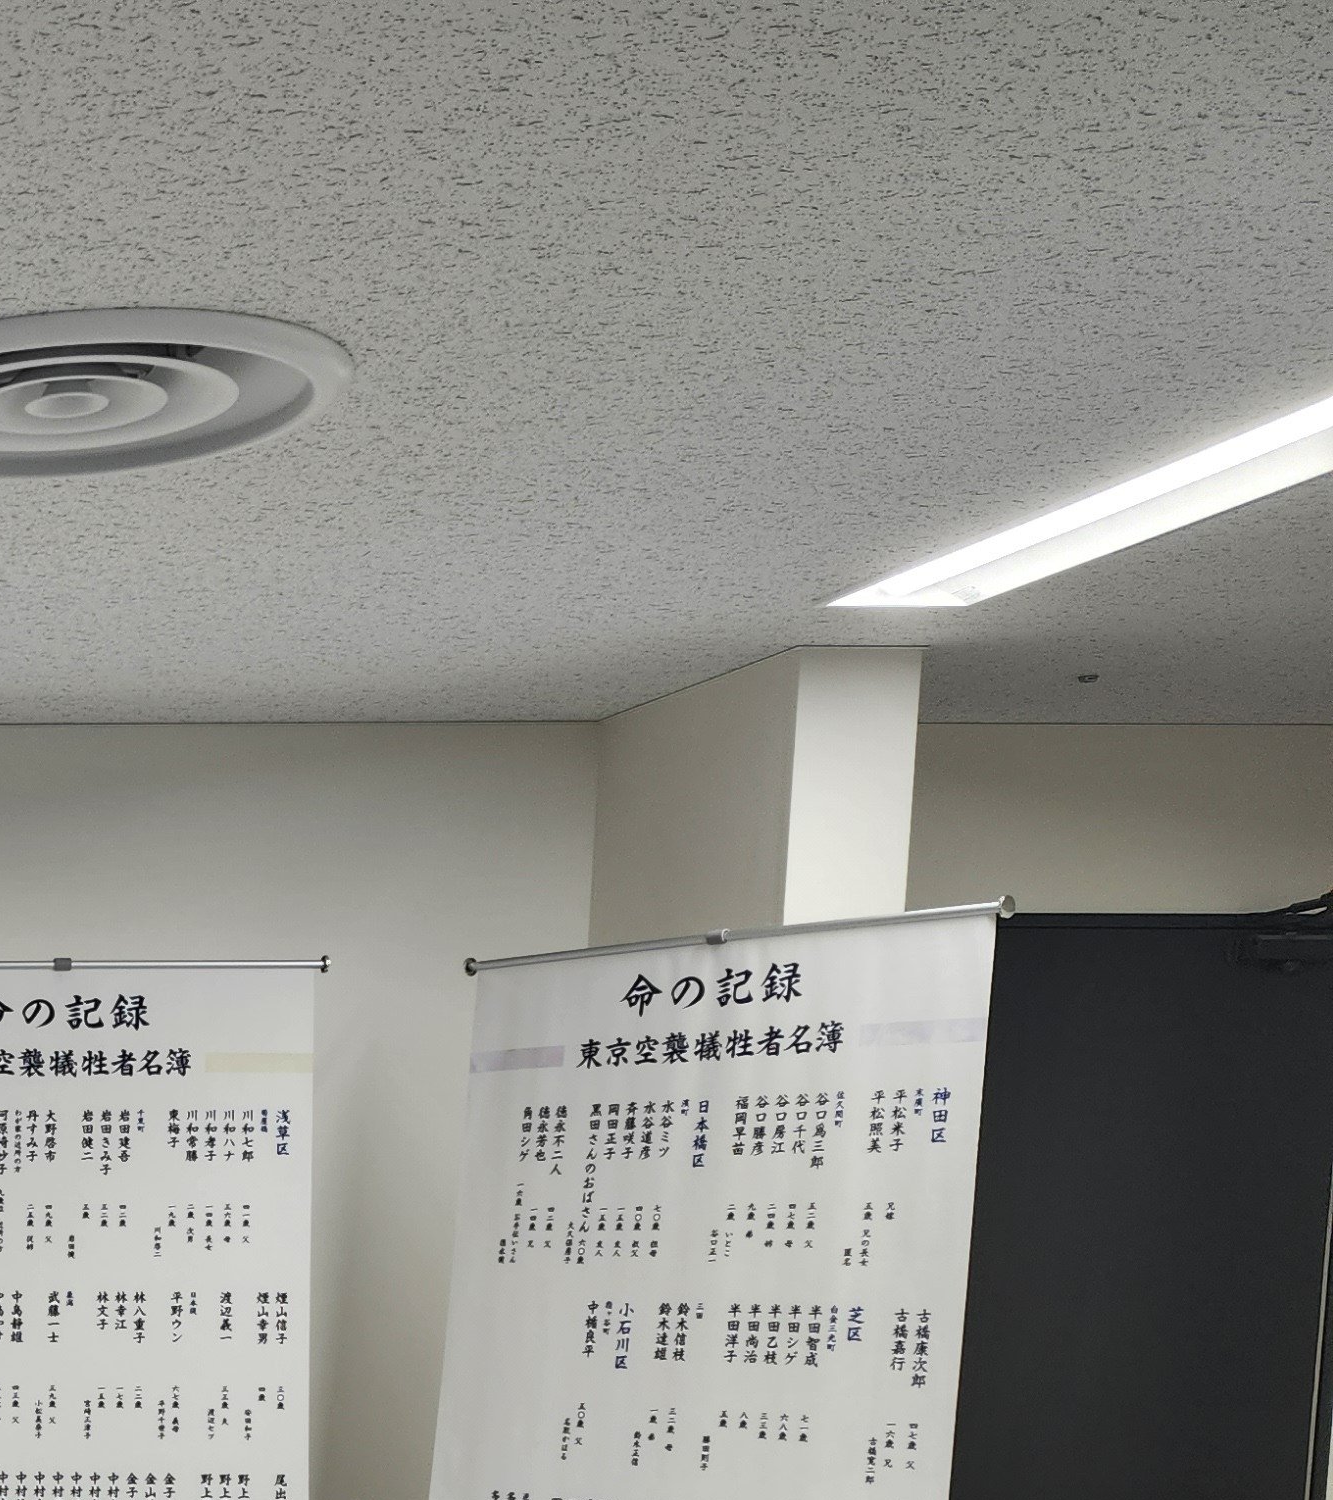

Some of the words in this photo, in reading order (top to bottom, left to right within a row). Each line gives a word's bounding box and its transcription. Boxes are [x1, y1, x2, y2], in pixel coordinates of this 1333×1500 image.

[619, 962, 803, 1018] 命の記録
[575, 1019, 845, 1070] 東京空襲犠牲者名簿
[203, 1109, 218, 1162] 川和孝子
[222, 1109, 237, 1162] 川和ハナ
[241, 1109, 255, 1163] 川和七郎
[275, 1109, 292, 1156] 浅草区
[549, 1104, 568, 1176] 徳永不二人
[602, 1103, 621, 1161] 岡田正子
[658, 1099, 675, 1158] 水谷ミツ
[691, 1099, 710, 1169] 日本橋区
[749, 1094, 770, 1157] 谷口勝彦
[791, 1093, 811, 1155] 谷口千代
[866, 1089, 886, 1154] 平松照美
[888, 1088, 908, 1152] 平松米子
[930, 1086, 952, 1144] 神田区
[578, 1103, 603, 1234] 黒田さんのおばさん
[95, 1290, 111, 1331] 林文子
[132, 1290, 147, 1344] 林八重子
[170, 1290, 184, 1343] 平野ウン
[614, 1302, 635, 1370] 小石川区
[671, 1302, 691, 1362] 鈴木信枝
[723, 1302, 742, 1364] 半田洋子
[762, 1303, 783, 1366] 半田乙枝
[803, 1304, 823, 1368] 半田智成
[846, 1305, 865, 1342] 芝区
[889, 1307, 910, 1372] 古橋嘉行
[910, 1308, 932, 1389] 古橋康次郎
